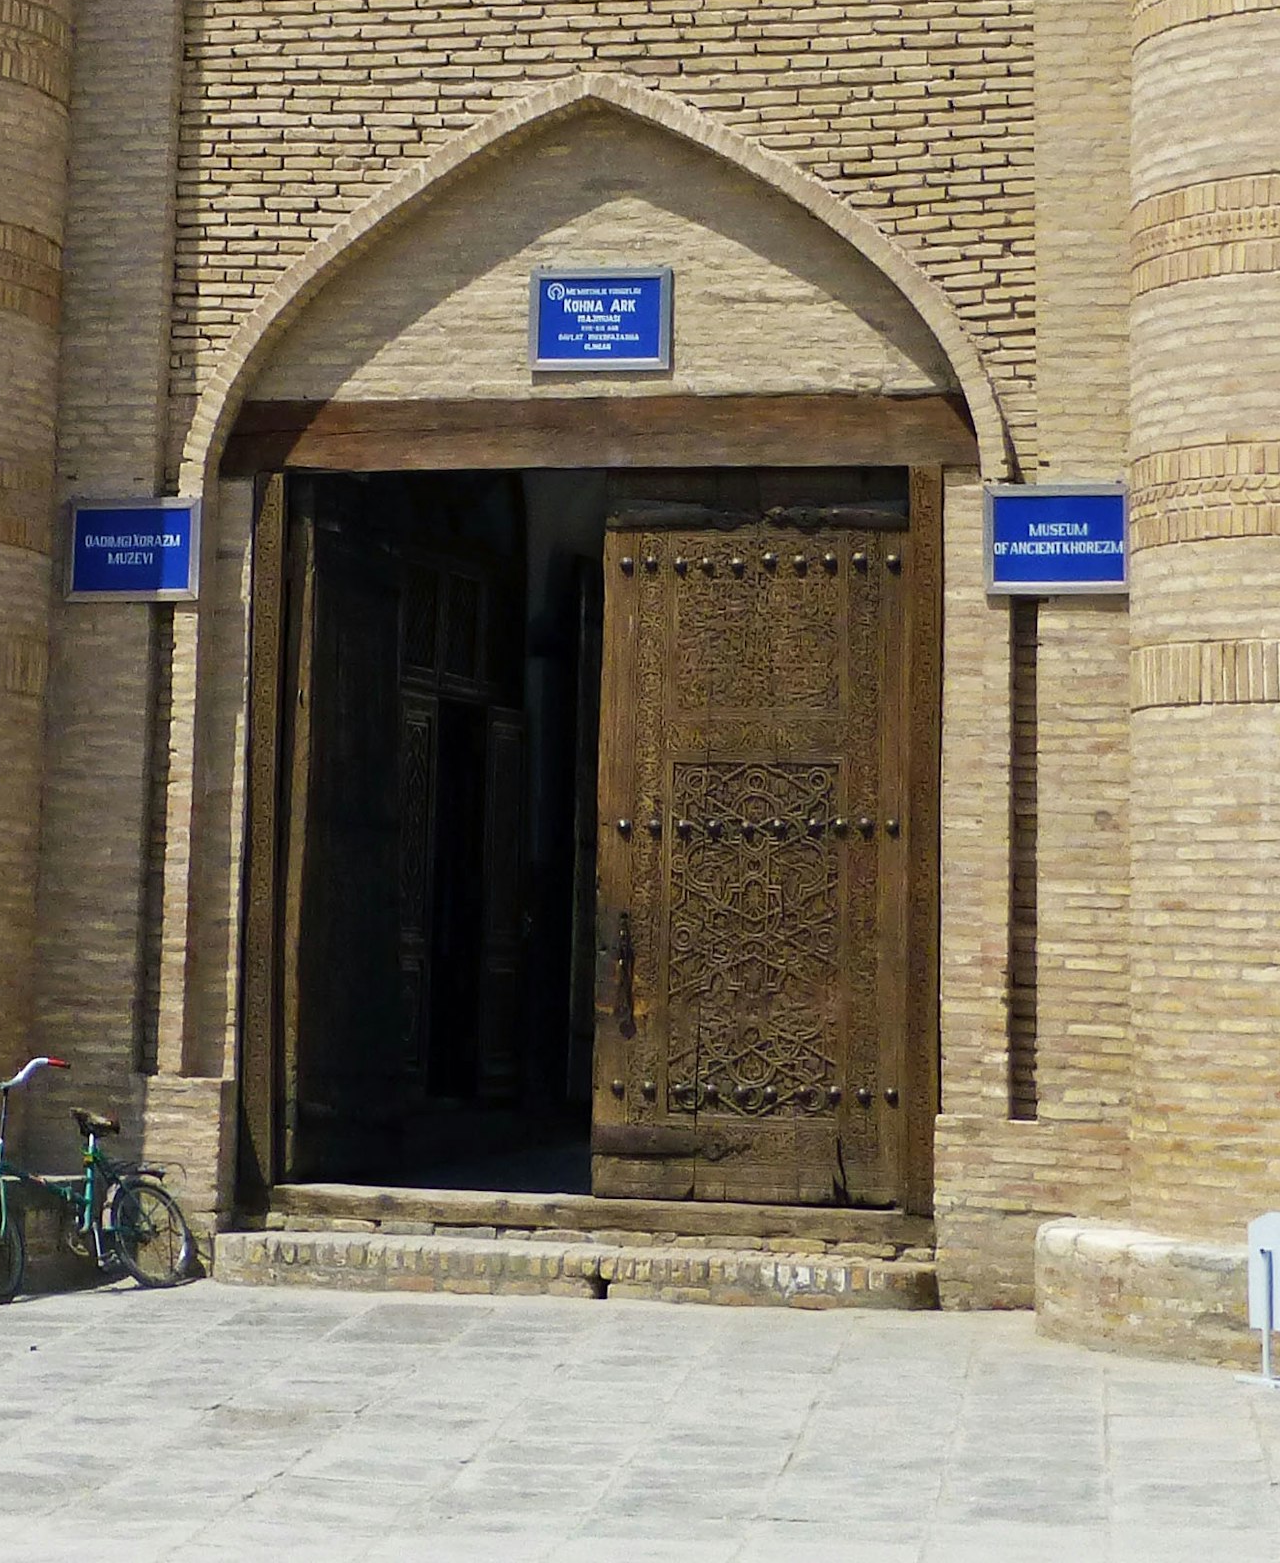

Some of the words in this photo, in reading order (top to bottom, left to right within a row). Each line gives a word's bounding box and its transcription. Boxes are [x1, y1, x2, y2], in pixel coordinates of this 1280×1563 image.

[610, 298, 637, 313] ARK
[1029, 522, 1089, 537] MUSEUM
[132, 534, 180, 547] XORAZM
[994, 541, 1009, 555] OF
[1010, 541, 1061, 555] ANCIENT
[1062, 540, 1124, 555] KHOREZM
[107, 551, 154, 565] MUZEYI
